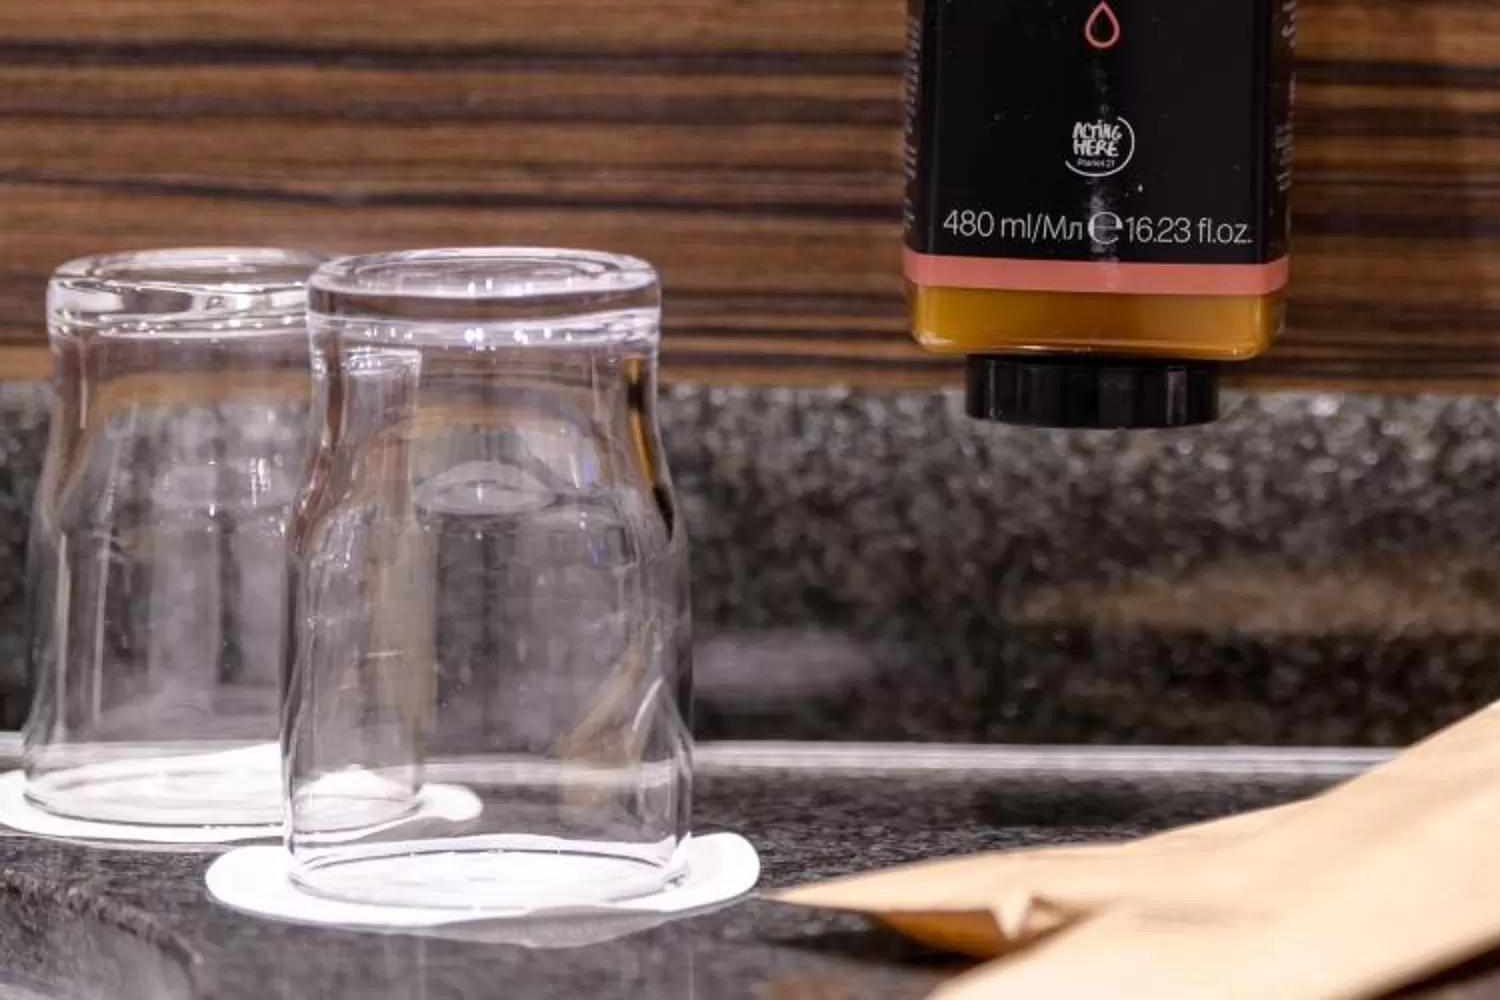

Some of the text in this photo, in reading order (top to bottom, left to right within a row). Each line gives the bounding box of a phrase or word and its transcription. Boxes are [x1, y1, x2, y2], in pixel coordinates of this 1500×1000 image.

[1073, 139, 1119, 157] HERE
[943, 209, 995, 238] 480
[1125, 216, 1191, 243] 16.23
[1196, 217, 1252, 244] fl.oz.
